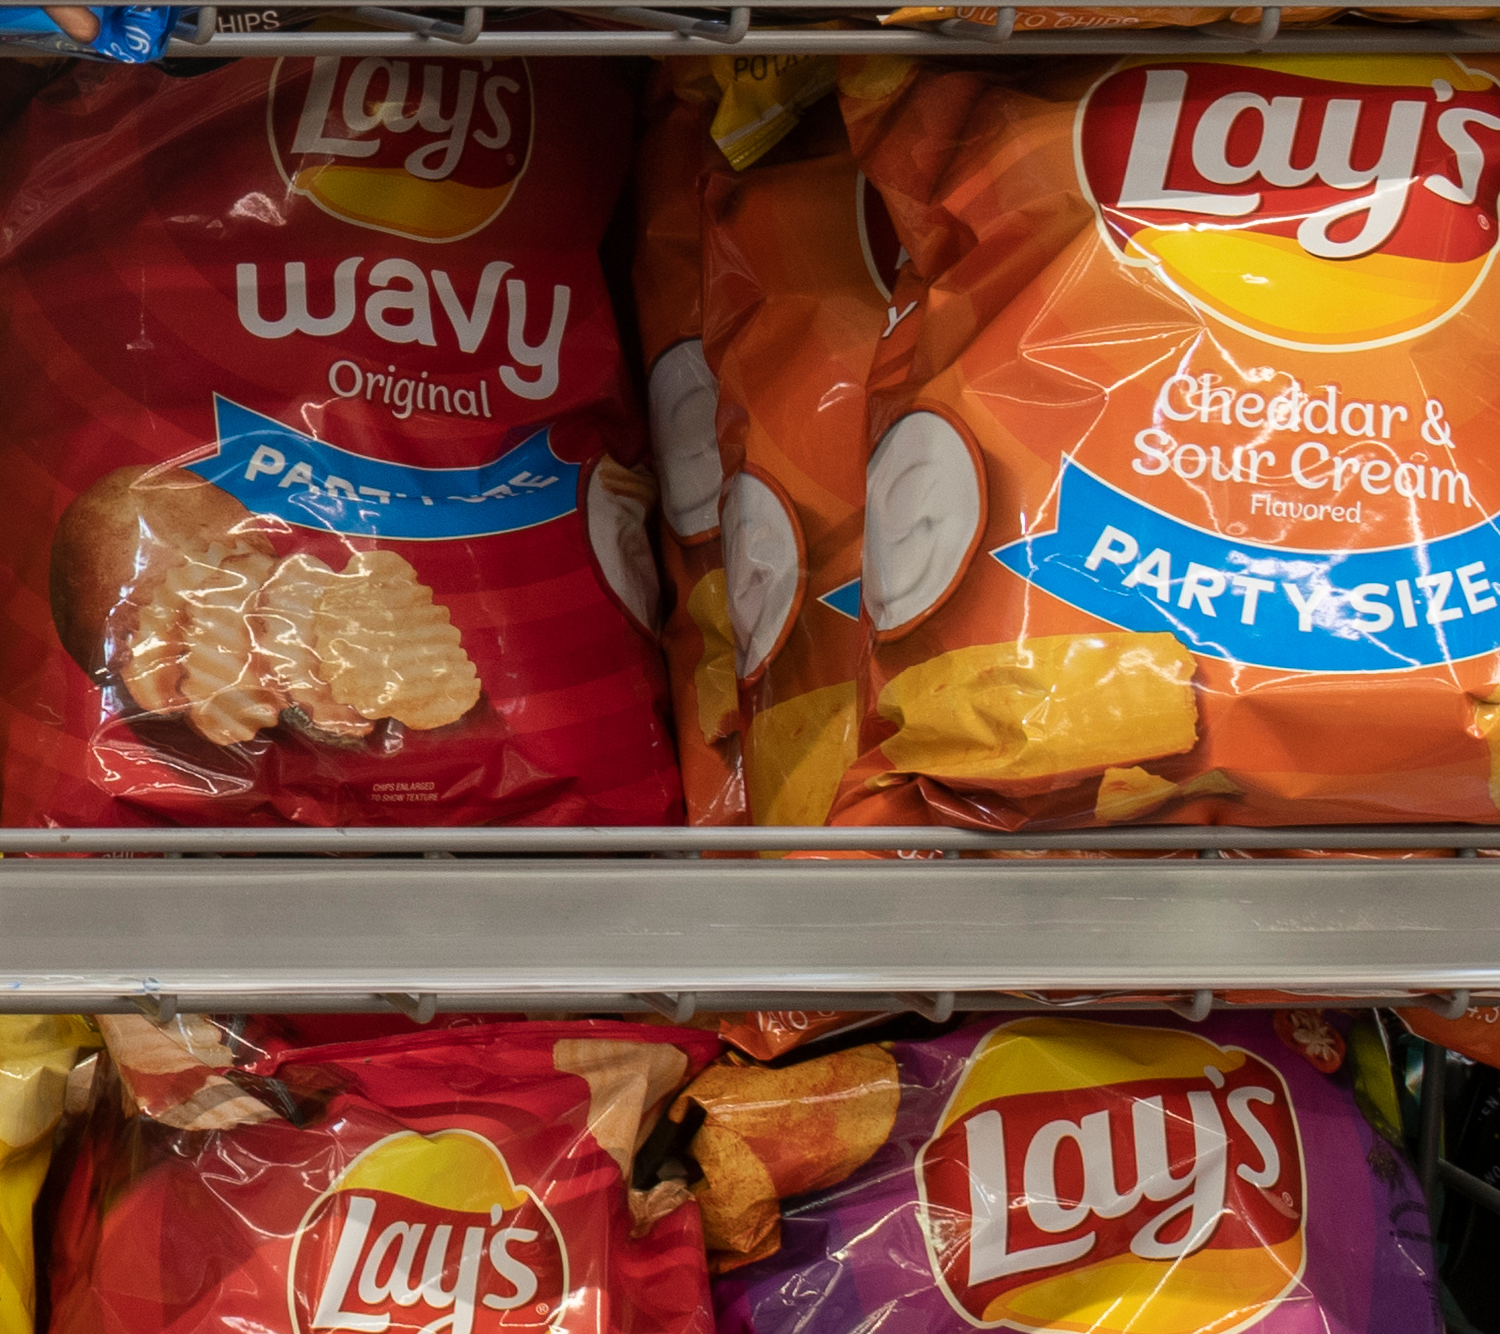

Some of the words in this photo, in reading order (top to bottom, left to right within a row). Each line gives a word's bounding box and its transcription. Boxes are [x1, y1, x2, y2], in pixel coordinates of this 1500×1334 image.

[237, 256, 571, 400] wavy
[328, 359, 492, 419] Original
[1159, 374, 1408, 441] Cheddar
[1422, 400, 1456, 451] &
[1133, 429, 1277, 485] Sour
[1289, 441, 1473, 507] Cream
[1250, 493, 1362, 525] Flavored
[1085, 526, 1322, 632] PARTY
[373, 782, 395, 792] CHIPS
[396, 781, 435, 791] ENLARGED
[969, 1068, 1281, 1286] Lay's
